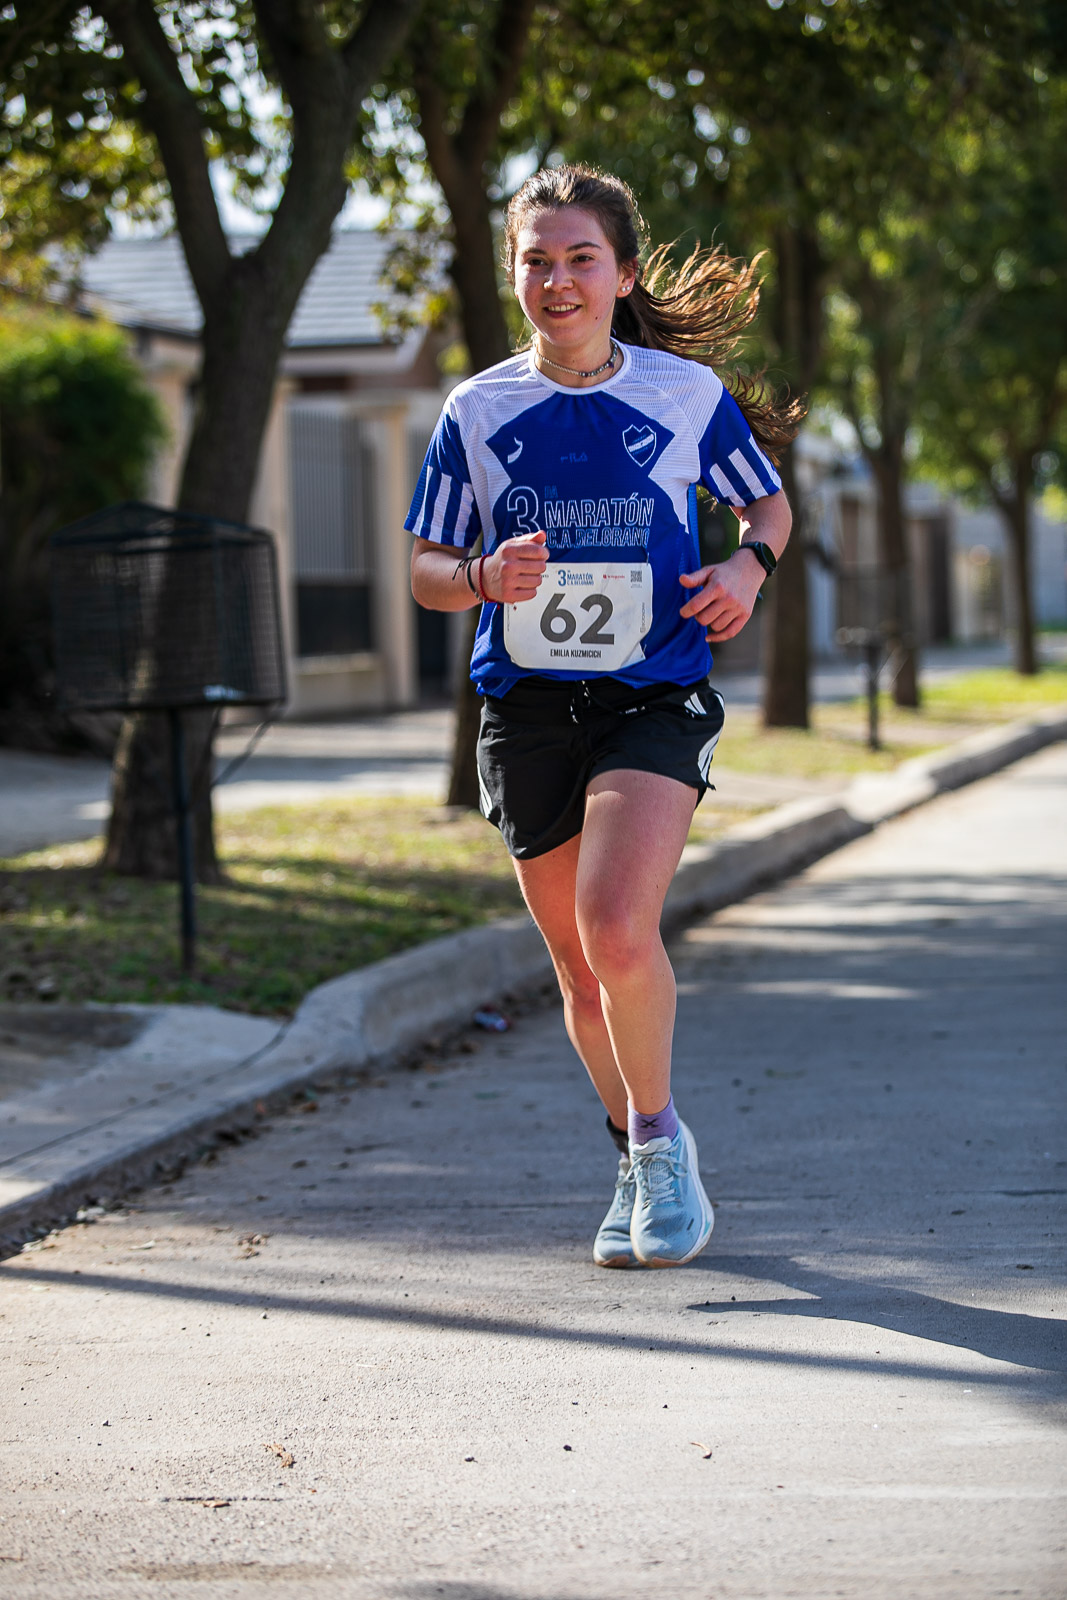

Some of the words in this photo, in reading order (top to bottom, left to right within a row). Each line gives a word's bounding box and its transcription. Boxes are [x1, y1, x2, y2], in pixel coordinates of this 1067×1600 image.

[507, 486, 541, 538] 3
[544, 492, 655, 529] MARATÓN
[557, 569, 567, 587] 3
[567, 572, 593, 580] MARATÓN
[540, 593, 615, 645] 62
[550, 649, 570, 658] EMILIA
[571, 649, 602, 659] KUZMICICH
